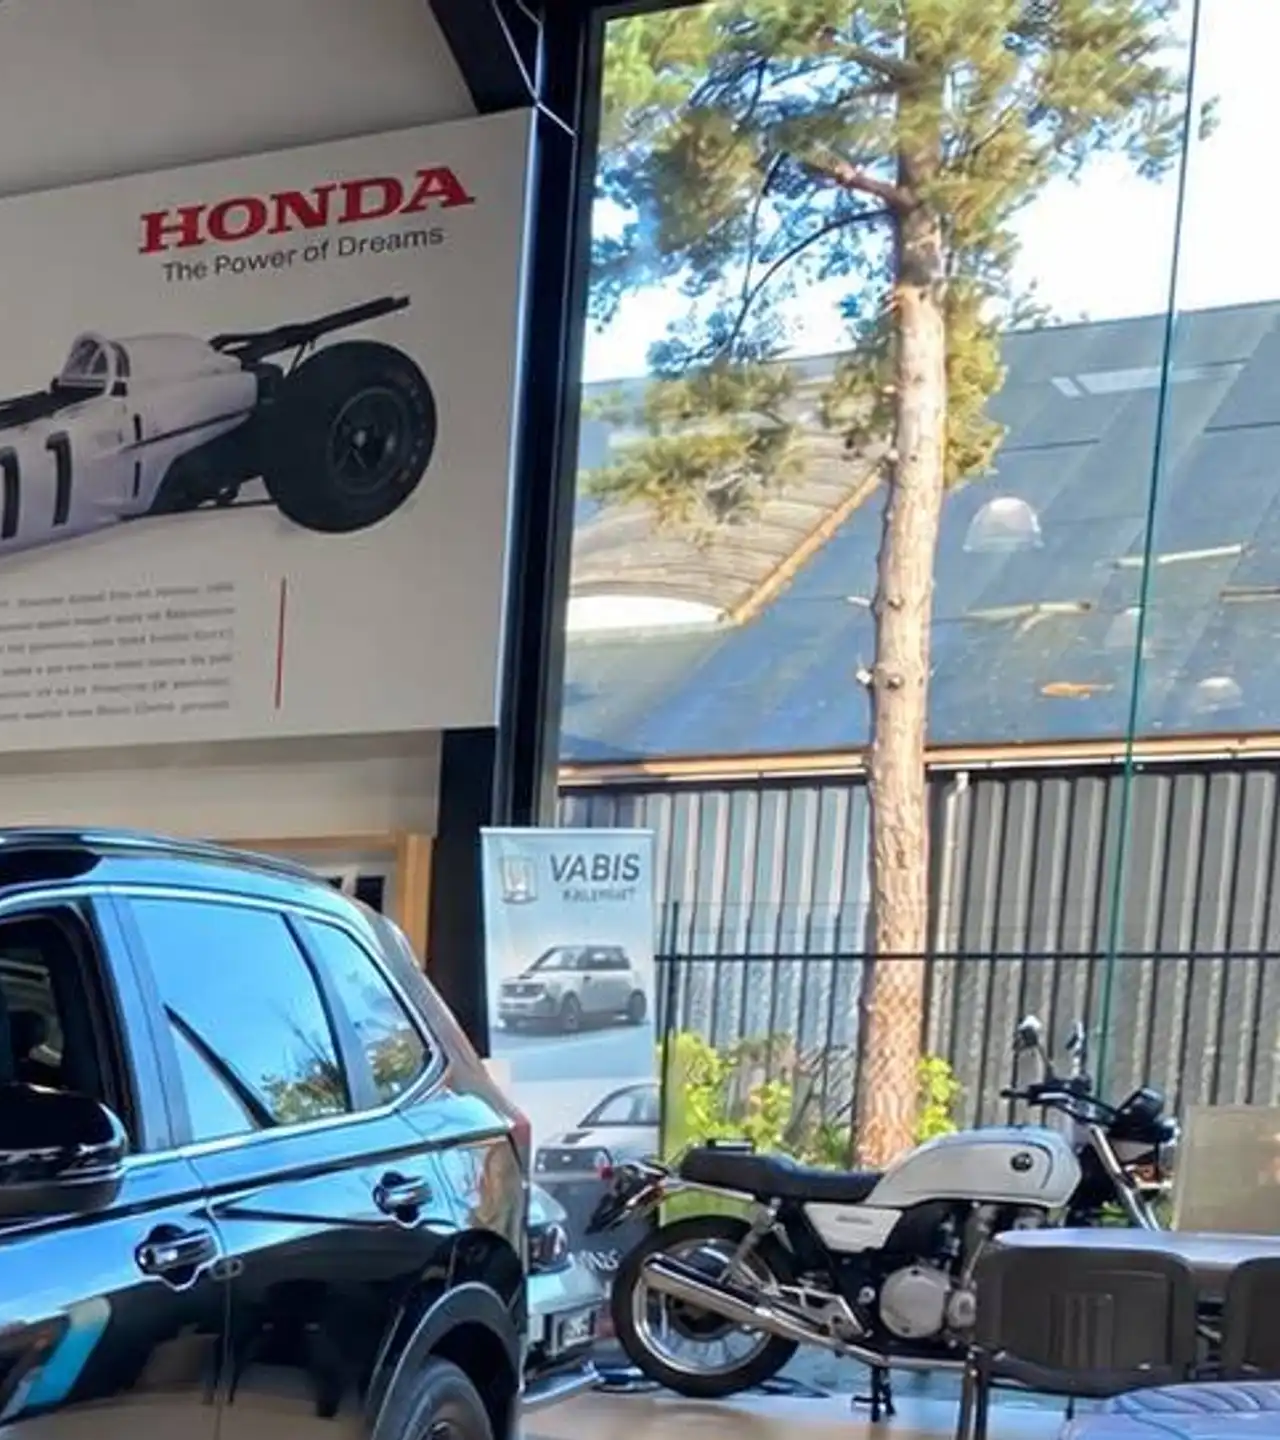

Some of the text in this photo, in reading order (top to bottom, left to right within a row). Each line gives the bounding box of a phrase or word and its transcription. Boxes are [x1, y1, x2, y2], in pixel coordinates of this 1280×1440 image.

[139, 165, 475, 253] HONDA
[163, 226, 444, 282] The Power of Dreams
[550, 852, 641, 883] VABIS
